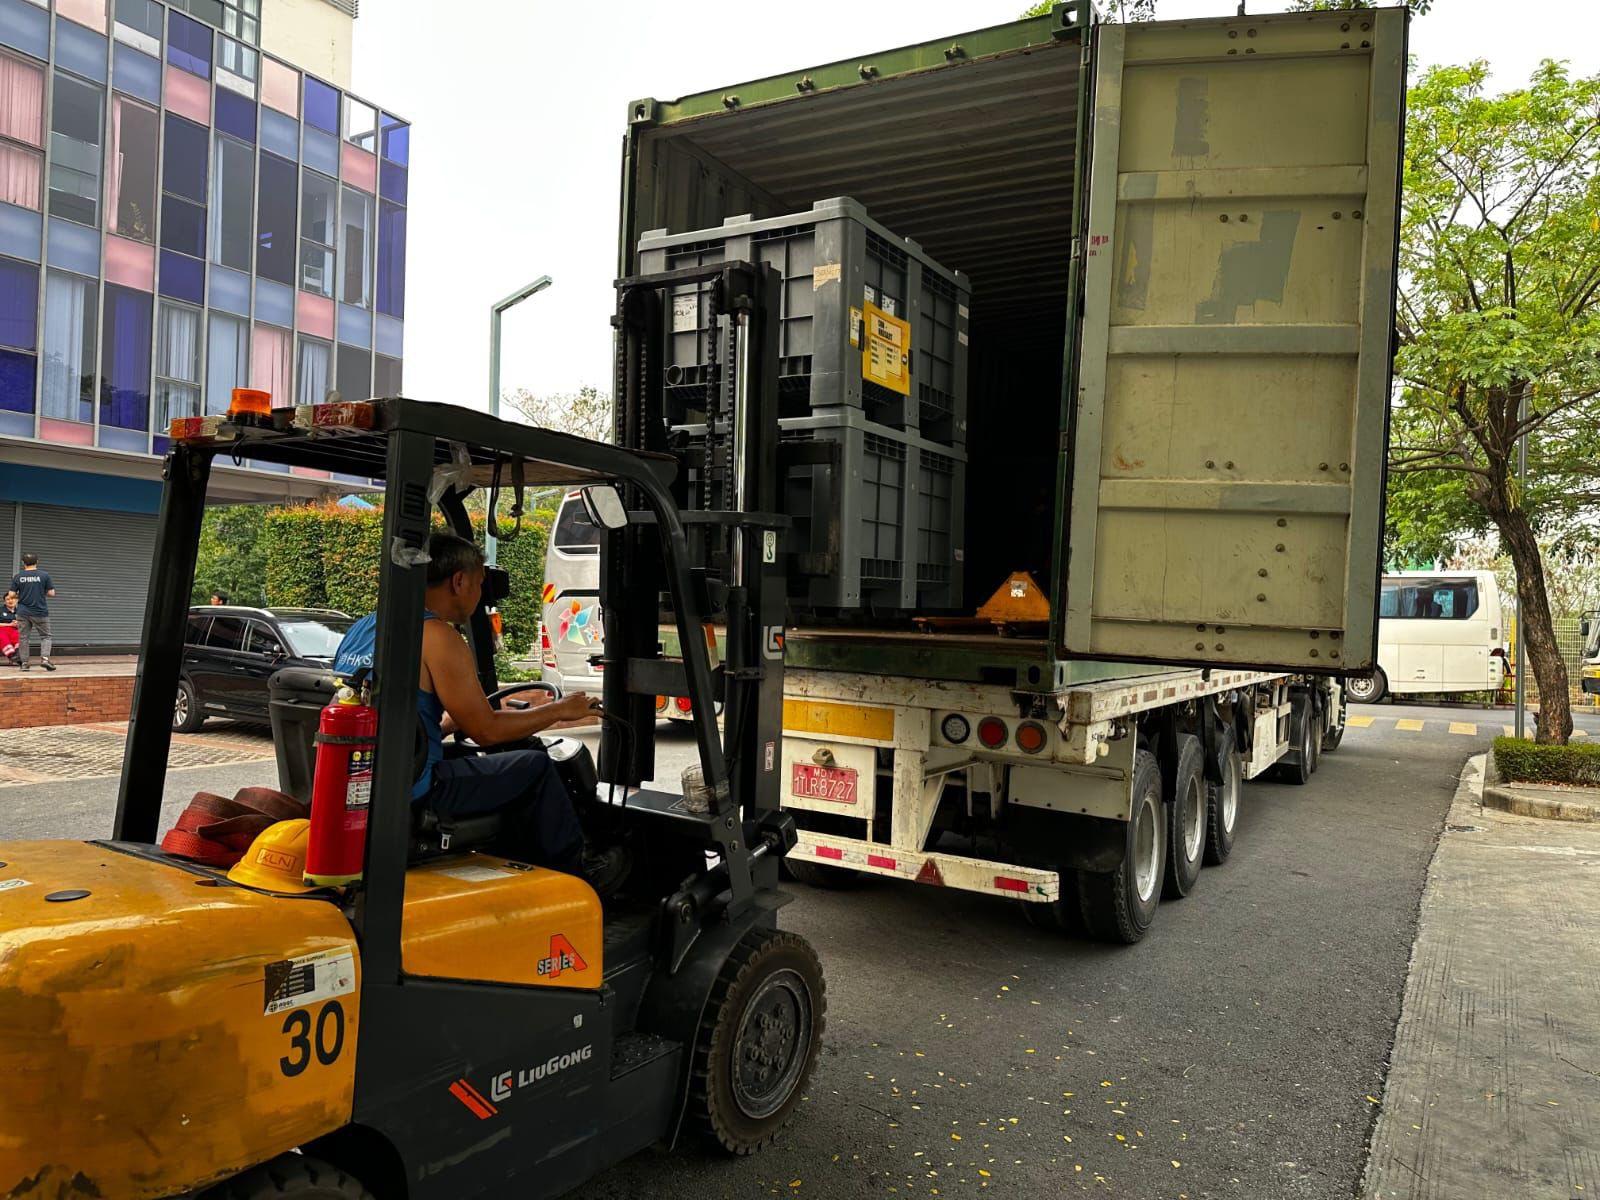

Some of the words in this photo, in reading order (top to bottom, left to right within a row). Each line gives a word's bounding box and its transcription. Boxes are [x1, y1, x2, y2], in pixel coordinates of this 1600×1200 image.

[813, 768, 835, 778] MDY
[537, 953, 575, 976] SERIES
[280, 1000, 345, 1077] 30
